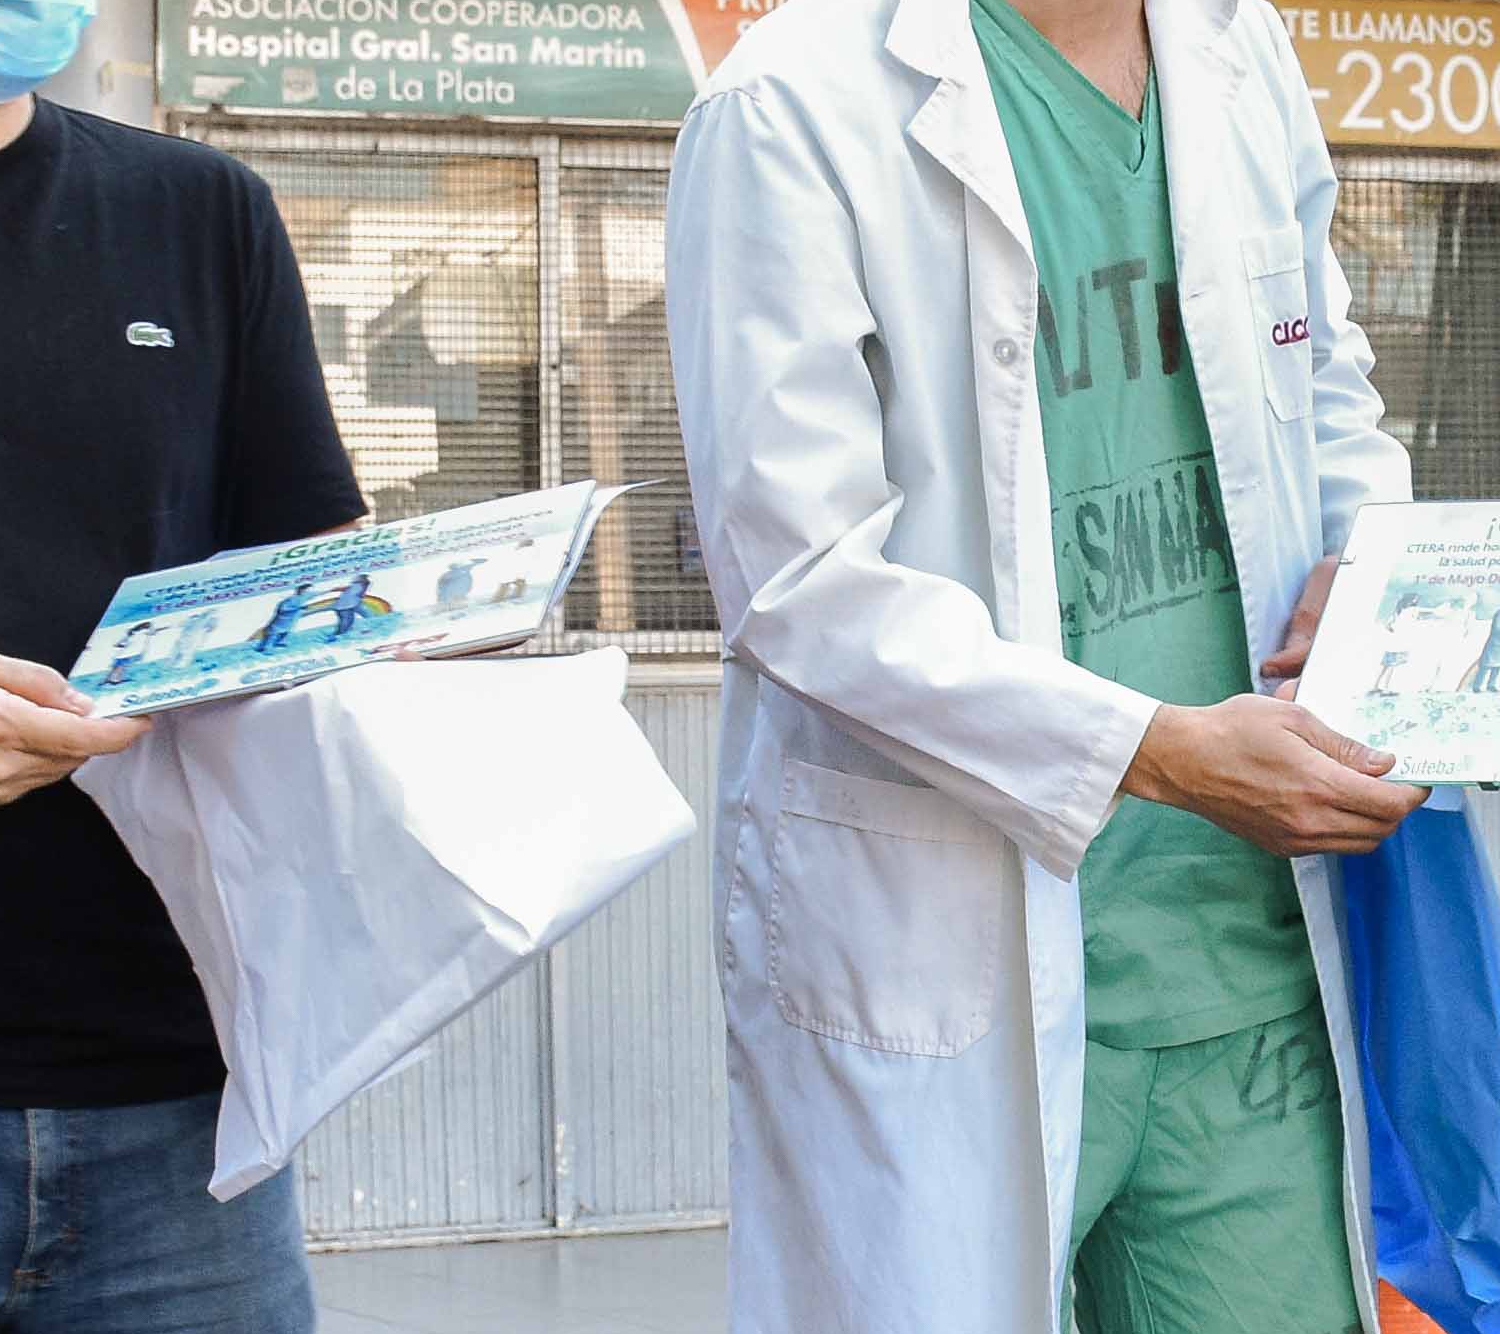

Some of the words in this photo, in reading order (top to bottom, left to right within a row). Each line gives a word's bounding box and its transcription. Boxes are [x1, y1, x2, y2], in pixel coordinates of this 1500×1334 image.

[187, 25, 341, 68] Hospital
[356, 28, 441, 63] Gral.
[450, 34, 518, 66] San
[1329, 11, 1494, 48] LLAMANOS
[334, 66, 378, 102] de
[388, 68, 426, 103] La
[435, 70, 516, 105] Plata
